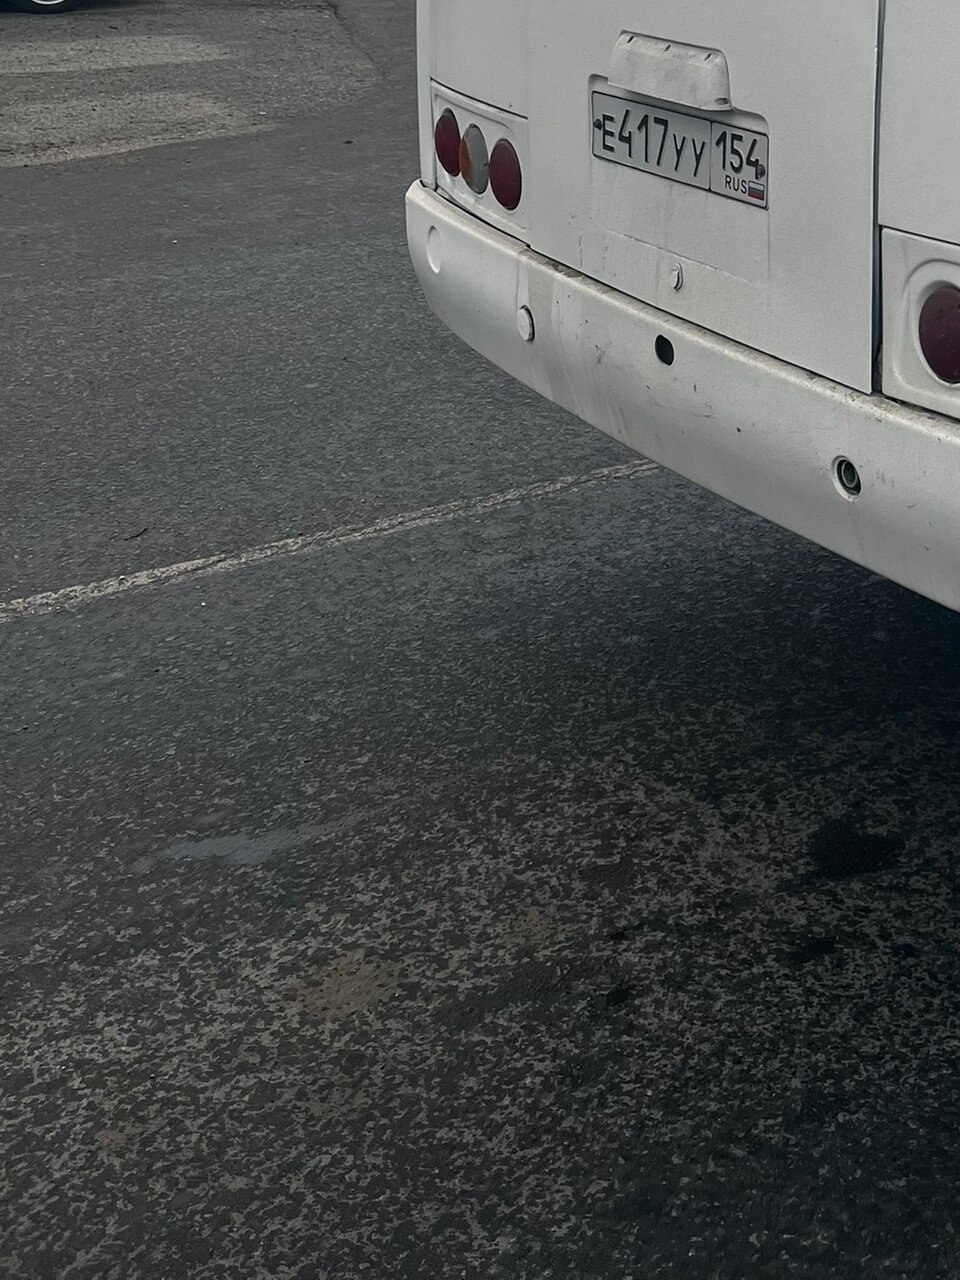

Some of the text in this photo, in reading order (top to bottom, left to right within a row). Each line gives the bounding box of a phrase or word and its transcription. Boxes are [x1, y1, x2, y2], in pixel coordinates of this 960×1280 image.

[602, 109, 761, 180] Е417УУ 154
[724, 174, 748, 194] RUS
